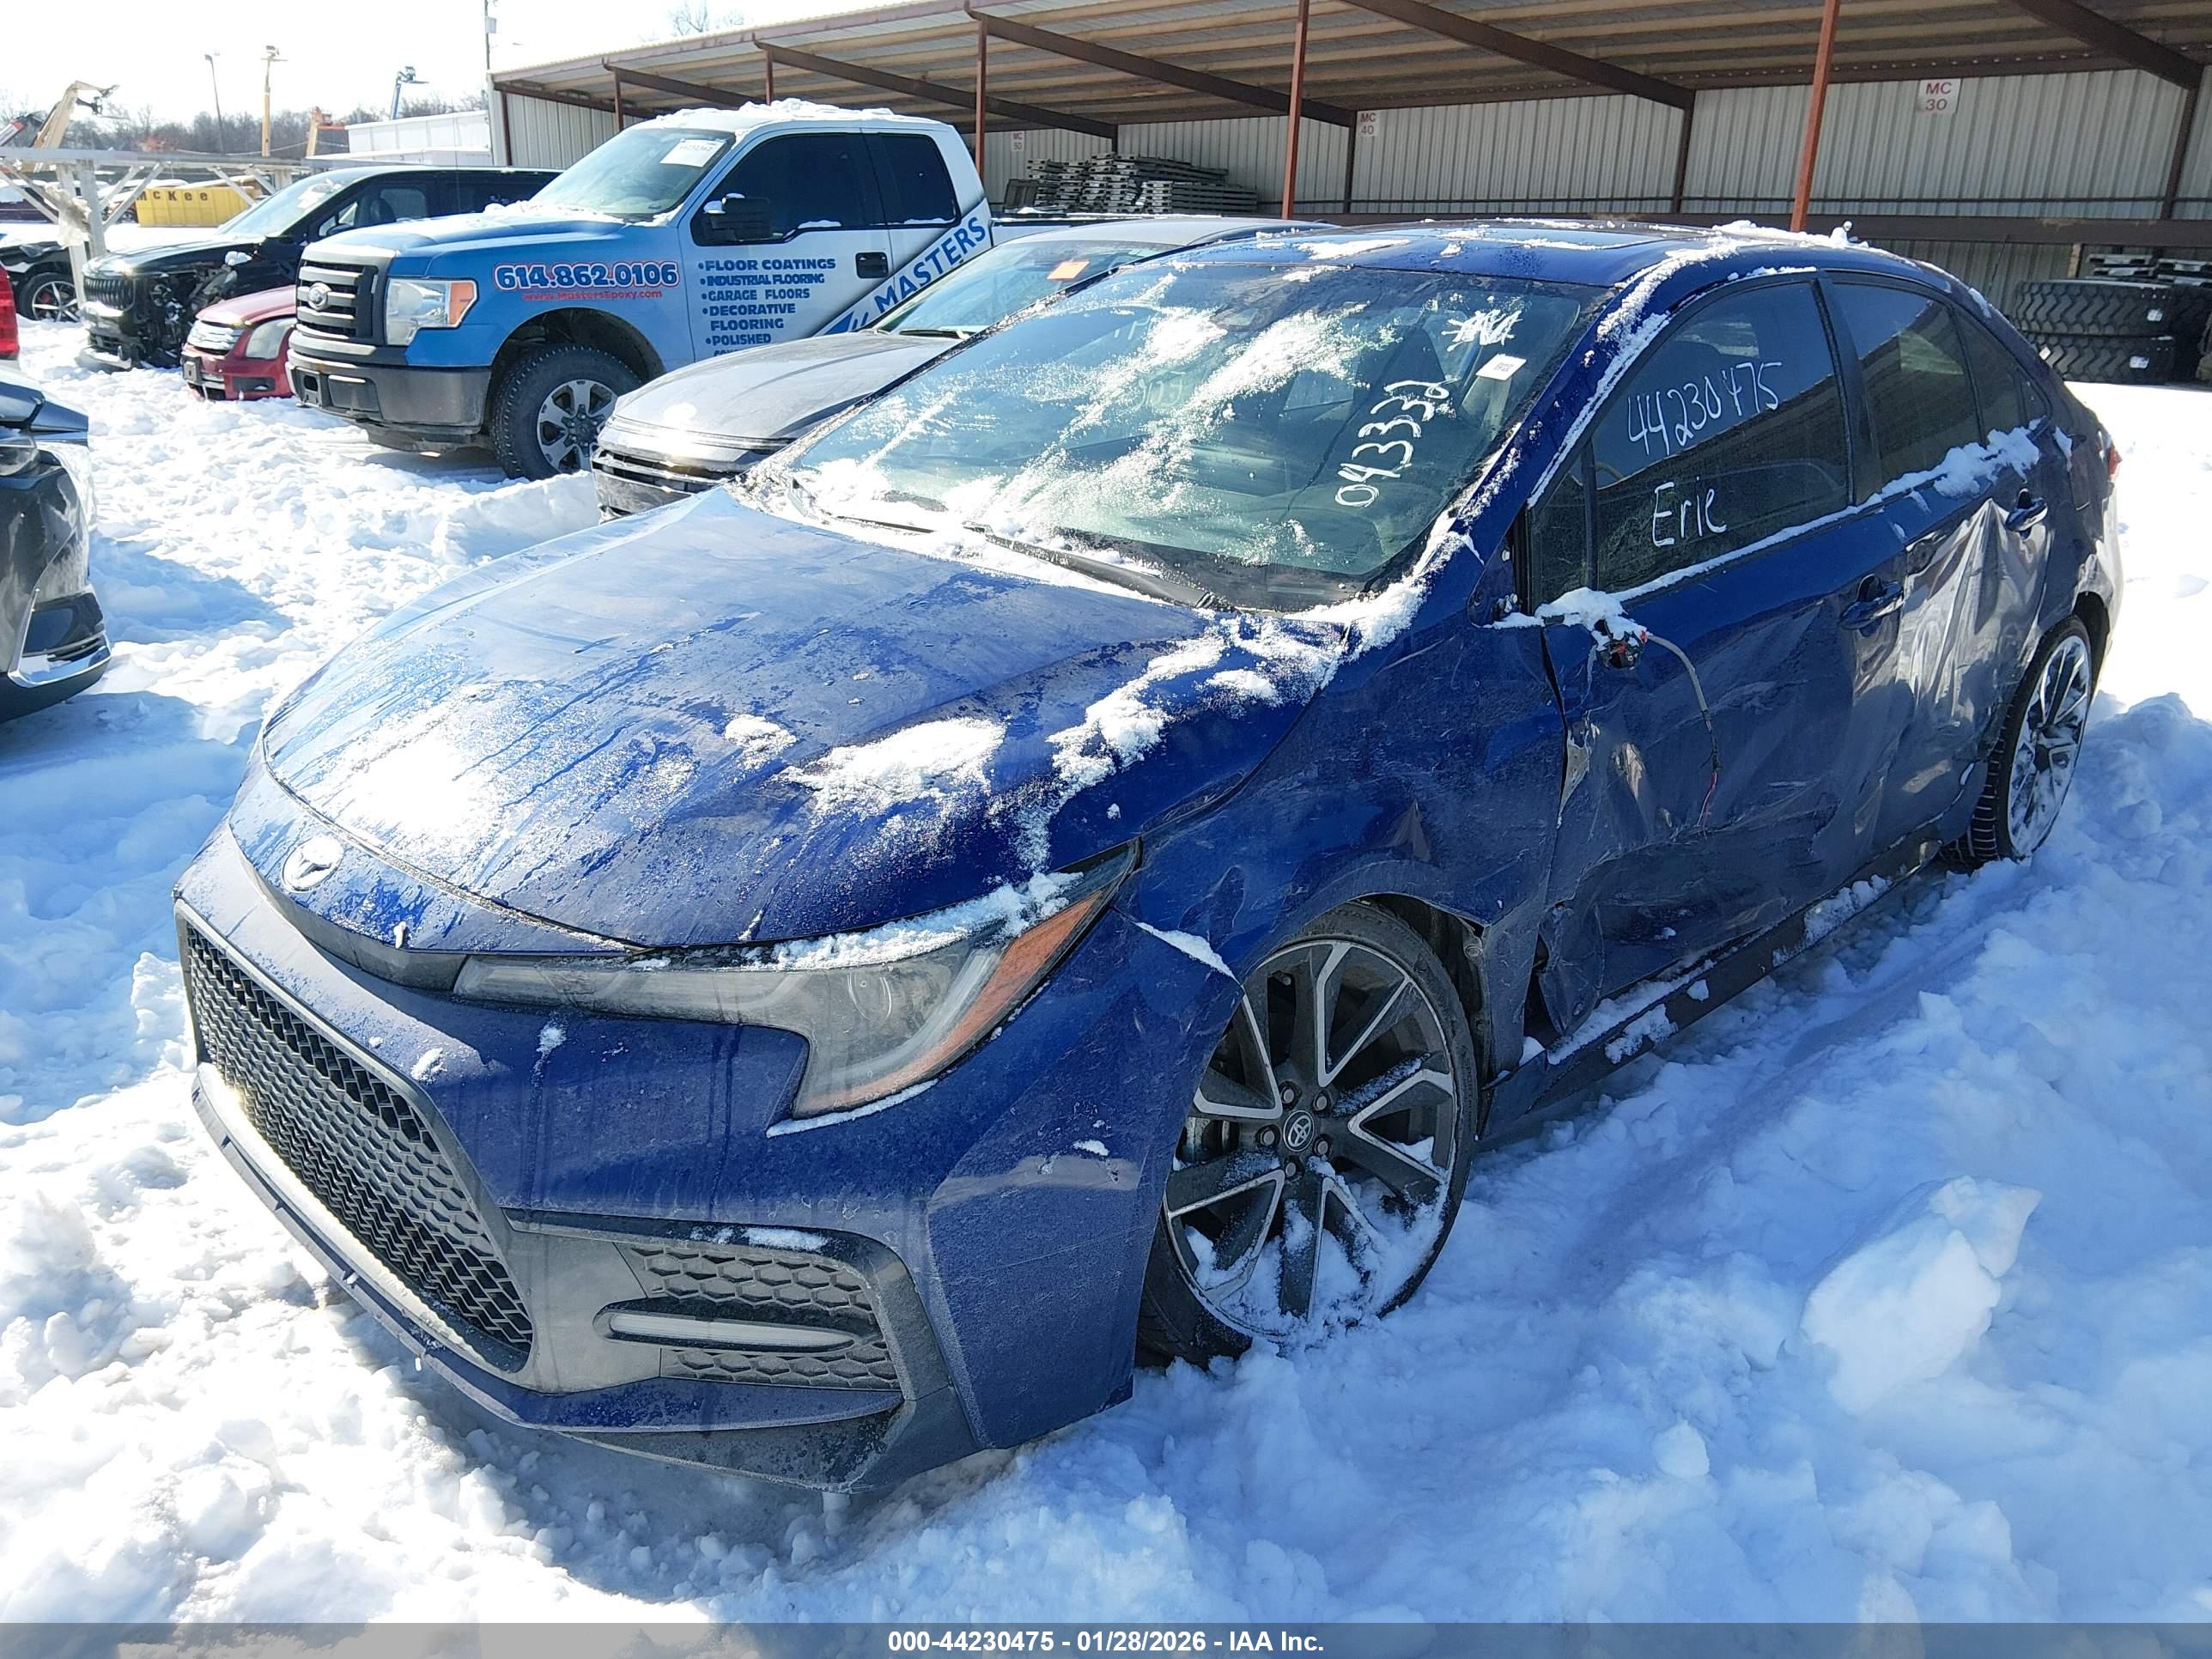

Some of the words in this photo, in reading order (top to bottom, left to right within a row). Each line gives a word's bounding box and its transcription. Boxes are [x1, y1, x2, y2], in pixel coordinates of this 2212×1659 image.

[1925, 82, 1952, 94] MC
[1925, 98, 1948, 111] 30
[1360, 112, 1376, 123] MC
[1360, 125, 1374, 135] 40
[705, 259, 758, 271] FLOOR
[762, 258, 836, 270] COATINGS
[874, 216, 986, 313] MASTERS
[495, 262, 678, 289] 614.862.0106
[707, 275, 772, 286] INDUSTRIAL
[772, 273, 825, 285] FLOORING
[708, 289, 757, 301] GARAGE
[765, 288, 811, 300] FLOORS
[709, 303, 796, 317] DECORATIVE
[710, 318, 784, 331] FLOORING
[712, 333, 772, 346] POLISHED
[1628, 362, 1782, 455] 44230475
